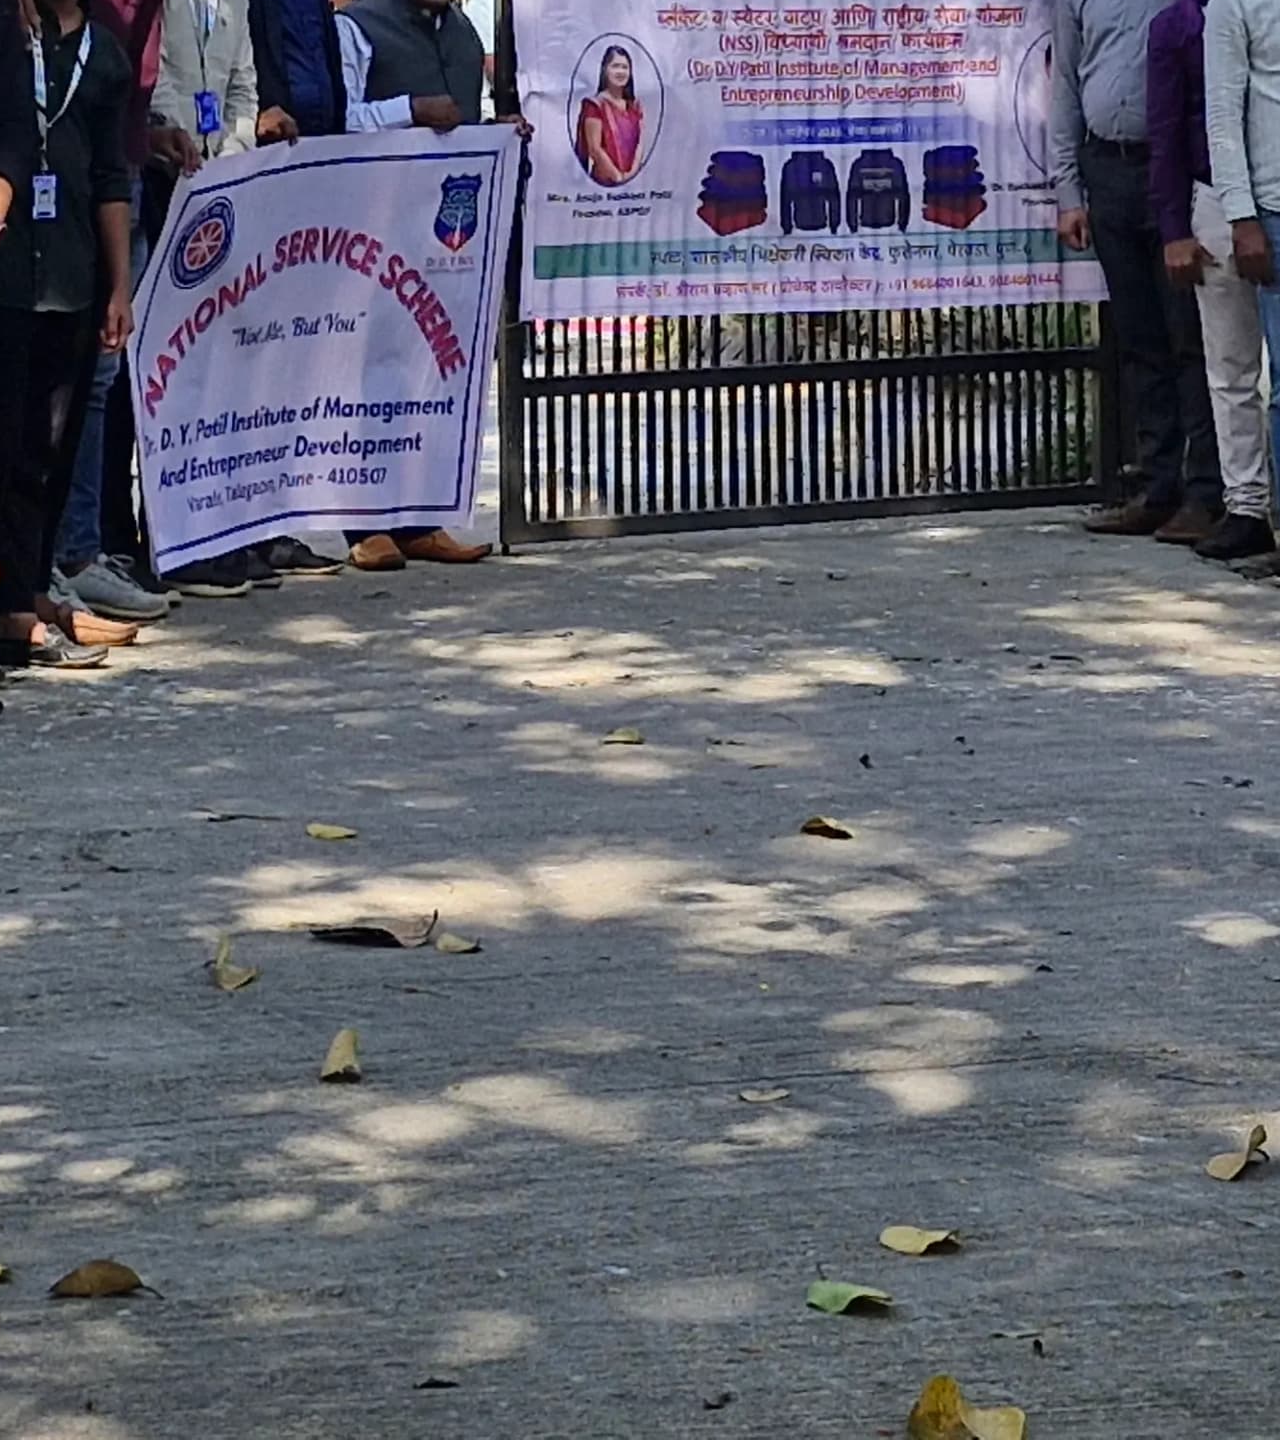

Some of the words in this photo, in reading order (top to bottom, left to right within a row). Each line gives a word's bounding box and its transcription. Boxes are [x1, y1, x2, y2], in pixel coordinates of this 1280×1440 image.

[719, 32, 761, 54] (NSS)
[144, 253, 268, 419] NATIONAL
[271, 226, 384, 279] SERVICE
[378, 253, 468, 382] SCHEME
[292, 316, 321, 337] But
[196, 412, 229, 442] Patil
[231, 404, 297, 433] Institute
[300, 397, 322, 421] of
[323, 394, 455, 426] Management
[158, 457, 188, 492] And
[190, 444, 290, 481] Entrepreneur
[294, 431, 423, 462] Development
[278, 471, 314, 490] Pune
[327, 466, 387, 486] 410507
